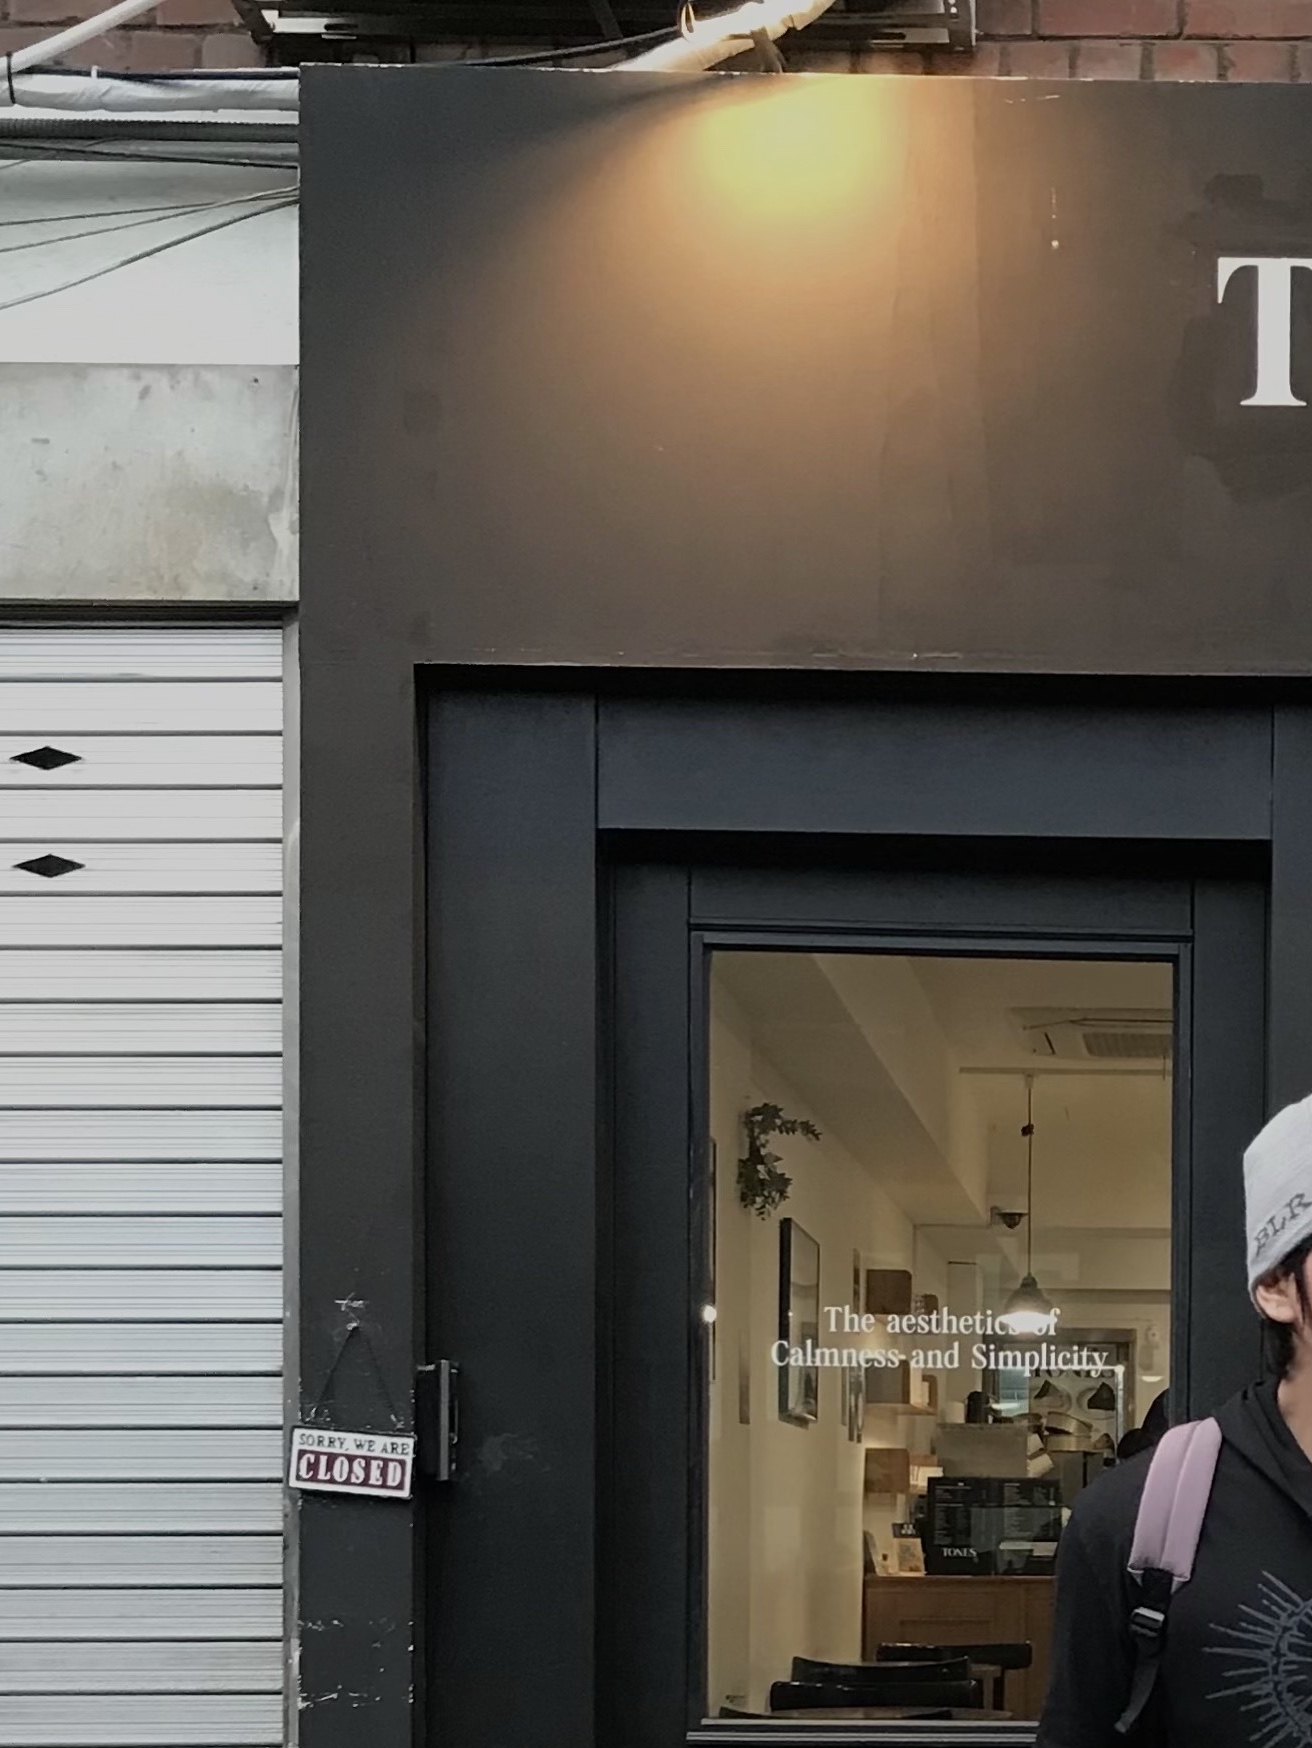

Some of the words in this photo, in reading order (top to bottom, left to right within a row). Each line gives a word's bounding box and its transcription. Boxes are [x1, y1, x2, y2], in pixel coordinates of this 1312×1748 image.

[824, 1305, 876, 1333] The
[771, 1339, 900, 1368] Calmness
[911, 1341, 960, 1369] and
[971, 1342, 1109, 1378] Simplicity
[299, 1433, 349, 1452] SORRY,
[353, 1438, 376, 1452] WE
[381, 1442, 410, 1456] ARE
[299, 1453, 402, 1487] CLOSED
